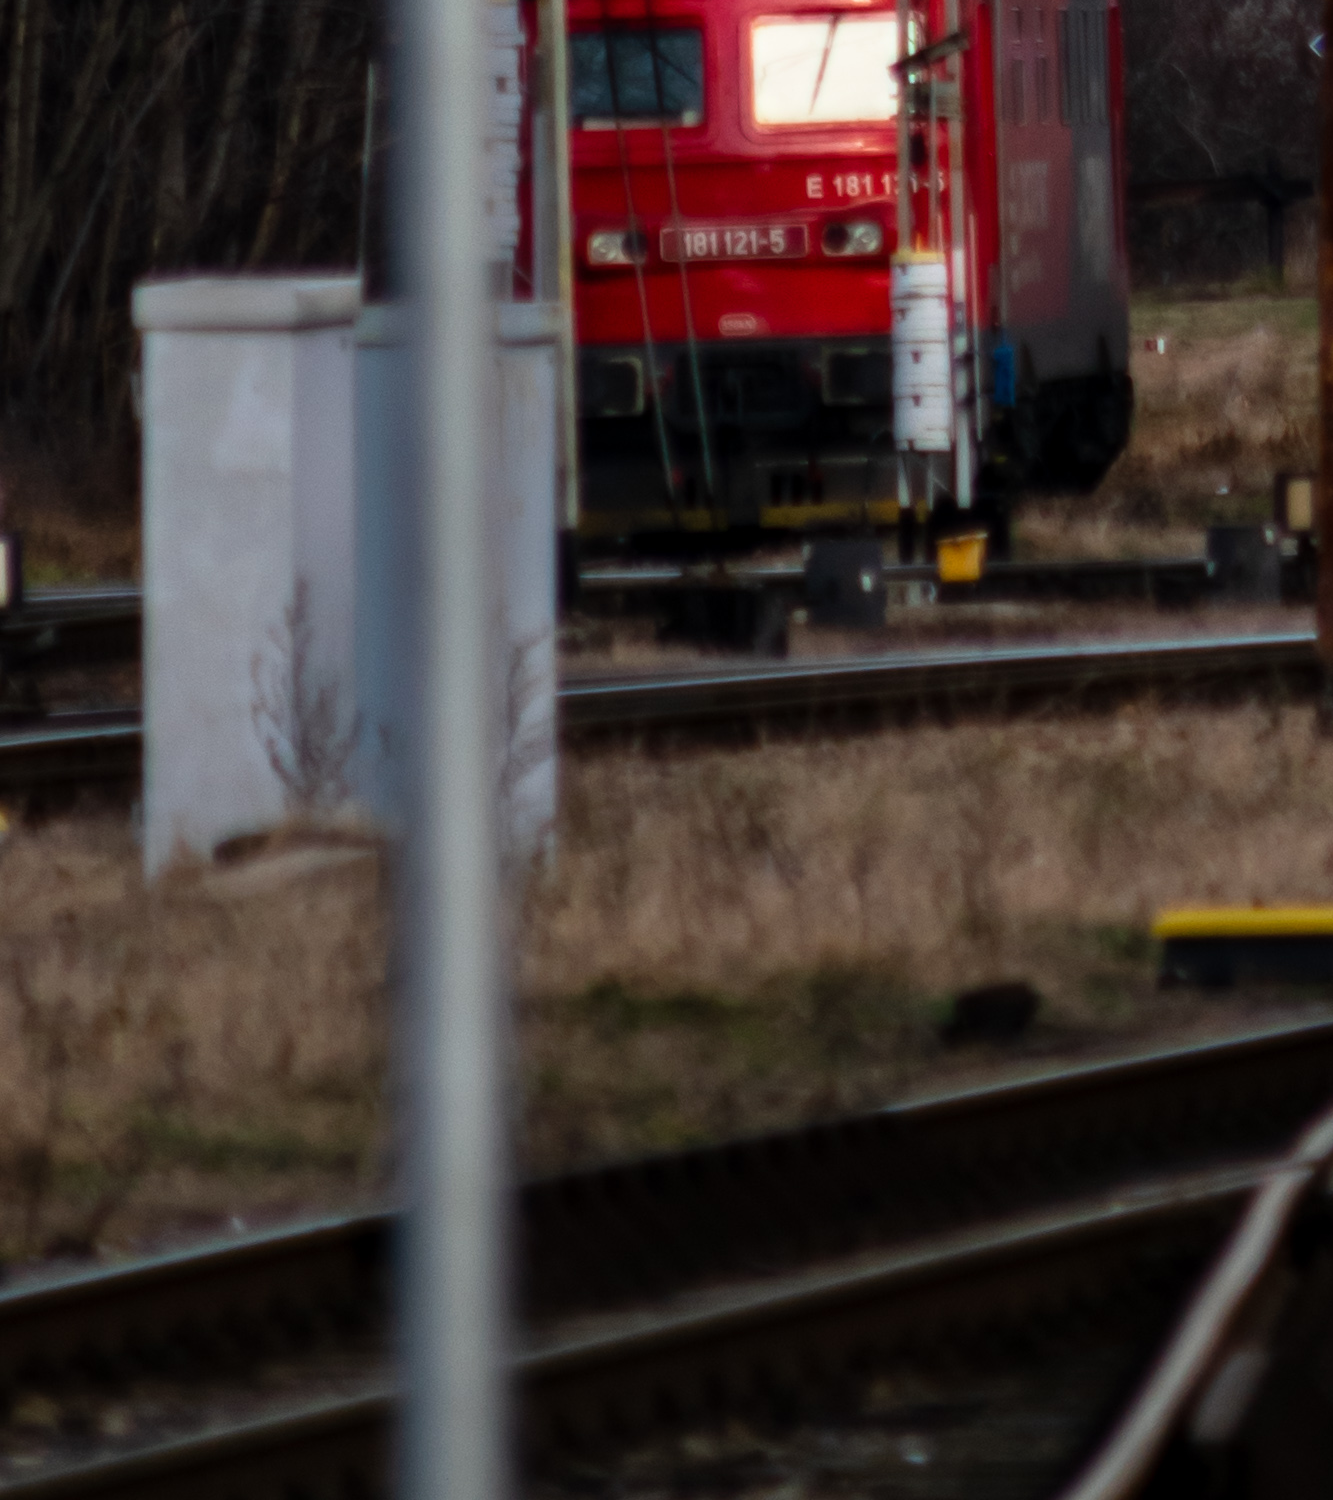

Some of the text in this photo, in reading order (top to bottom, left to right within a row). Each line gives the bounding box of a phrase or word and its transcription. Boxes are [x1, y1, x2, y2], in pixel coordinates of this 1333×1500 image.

[806, 174, 824, 199] E
[833, 173, 873, 197] 181
[684, 228, 786, 257] 181 121-5
